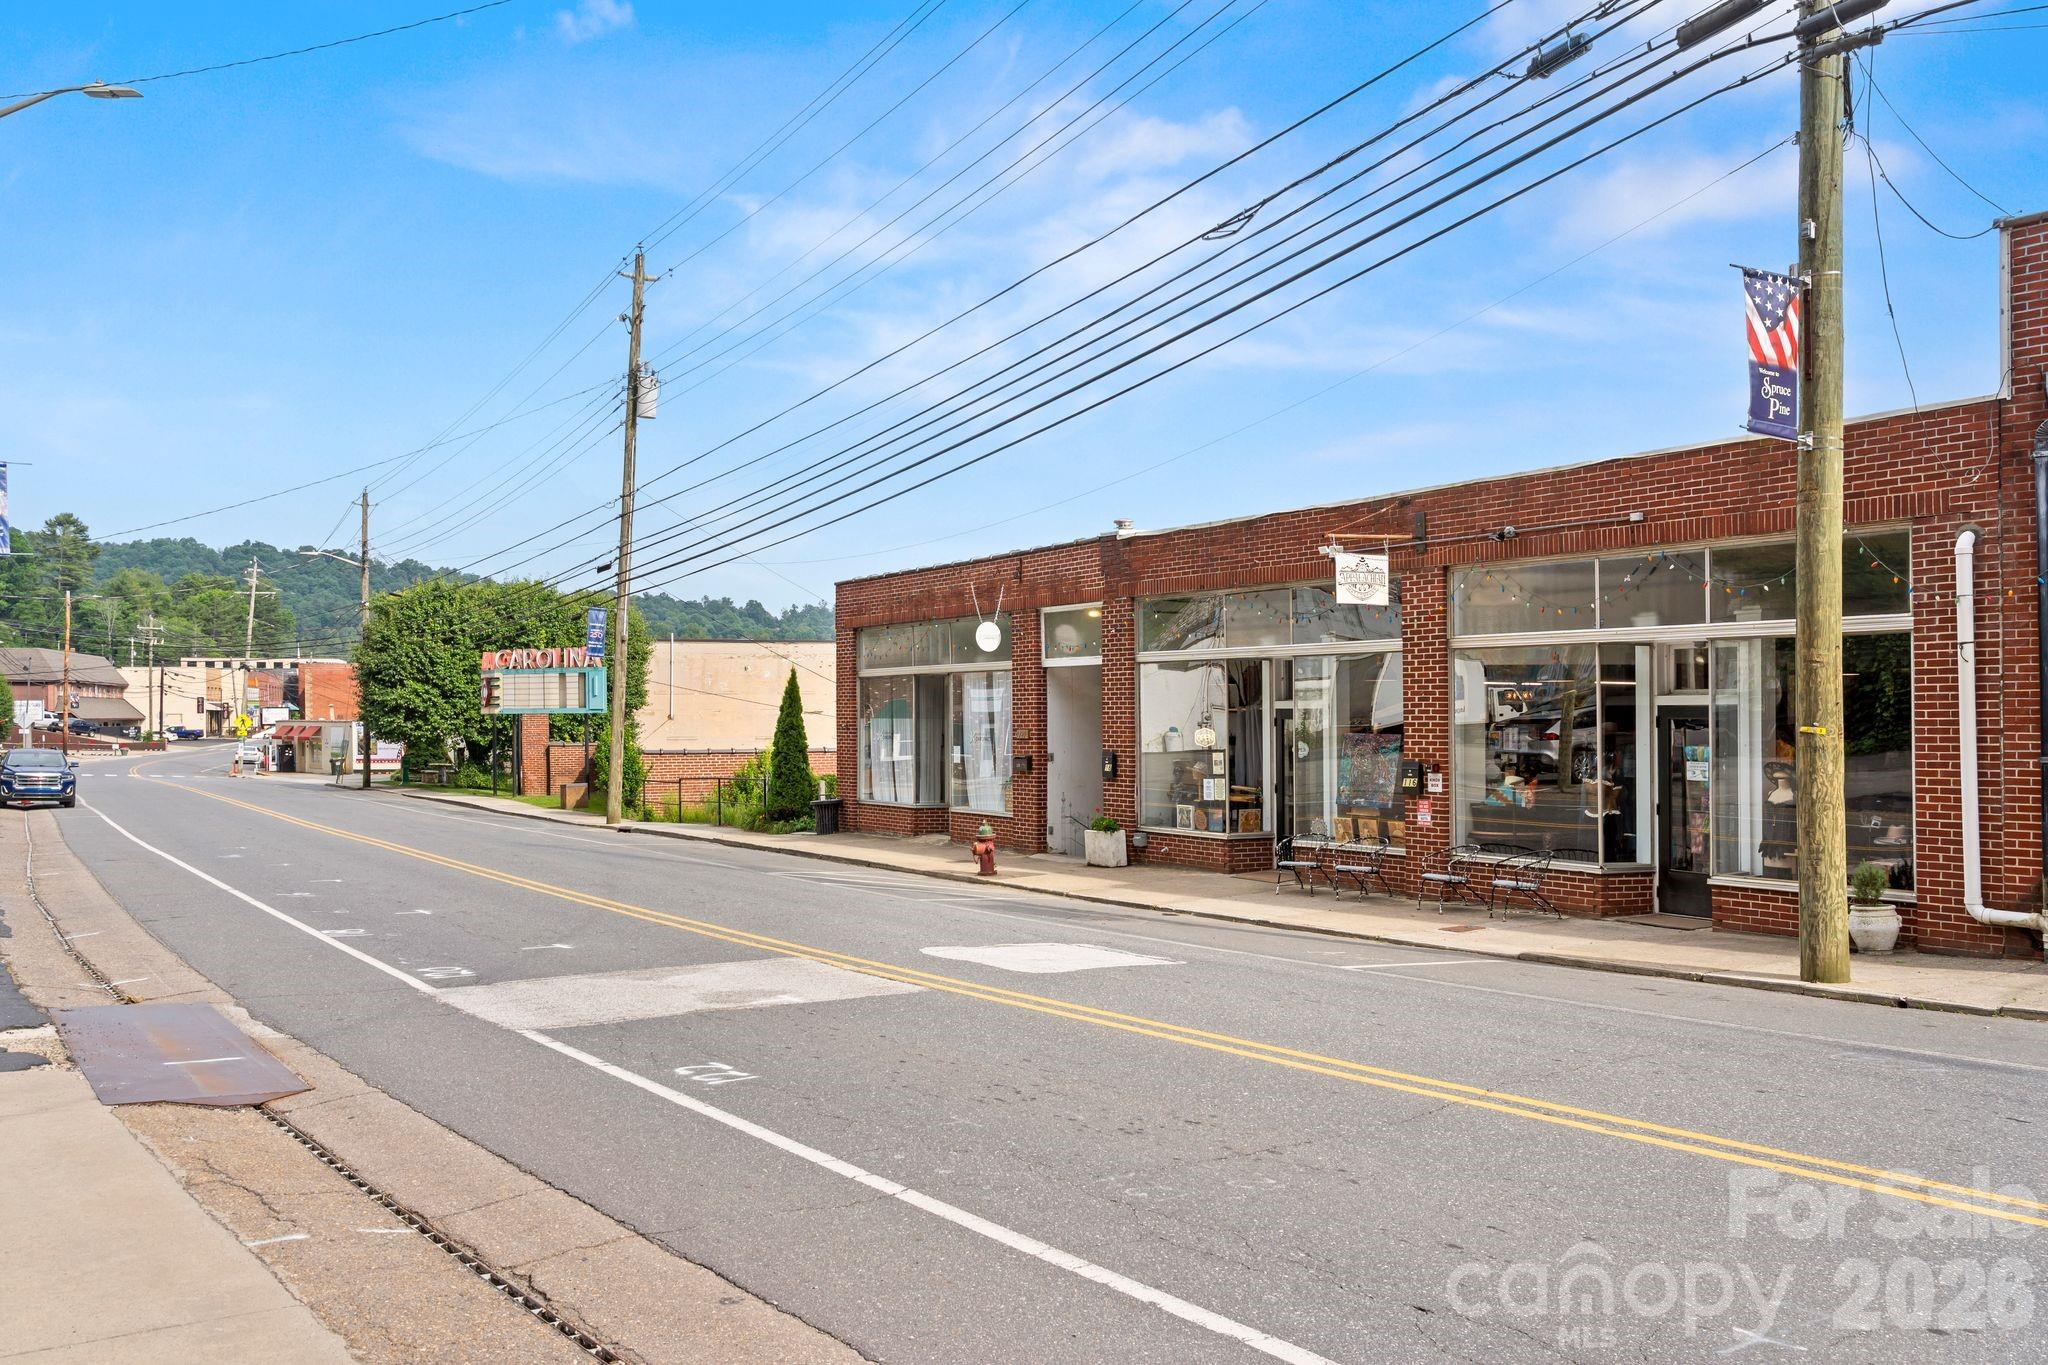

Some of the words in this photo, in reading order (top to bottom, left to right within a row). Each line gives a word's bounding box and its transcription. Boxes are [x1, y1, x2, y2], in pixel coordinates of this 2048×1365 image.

[1761, 376, 1792, 399] Spruce
[1768, 397, 1791, 419] Pine
[495, 647, 602, 669] CAROLINA
